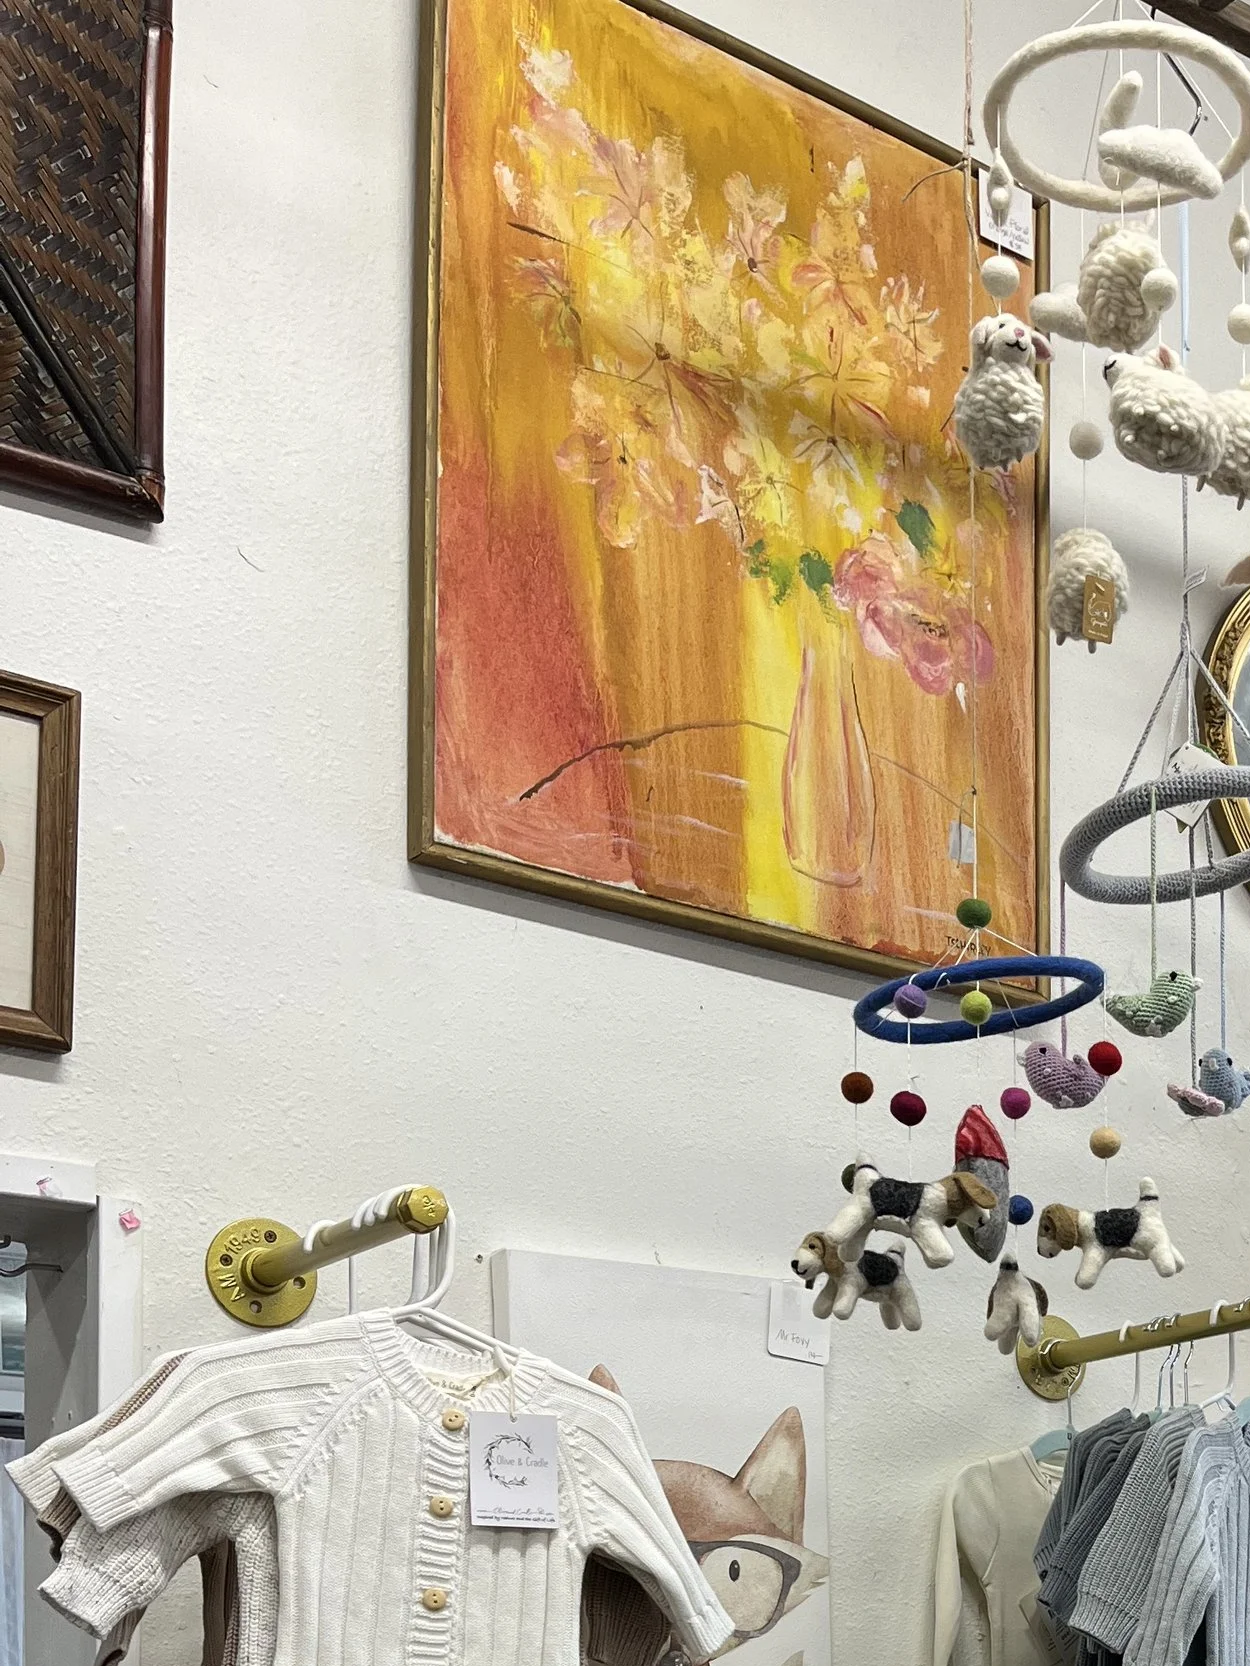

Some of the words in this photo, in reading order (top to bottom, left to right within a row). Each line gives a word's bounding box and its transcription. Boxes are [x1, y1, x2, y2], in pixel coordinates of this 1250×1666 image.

[496, 1455, 515, 1466] Olive
[517, 1456, 523, 1466] &
[525, 1456, 549, 1468] Cradle
